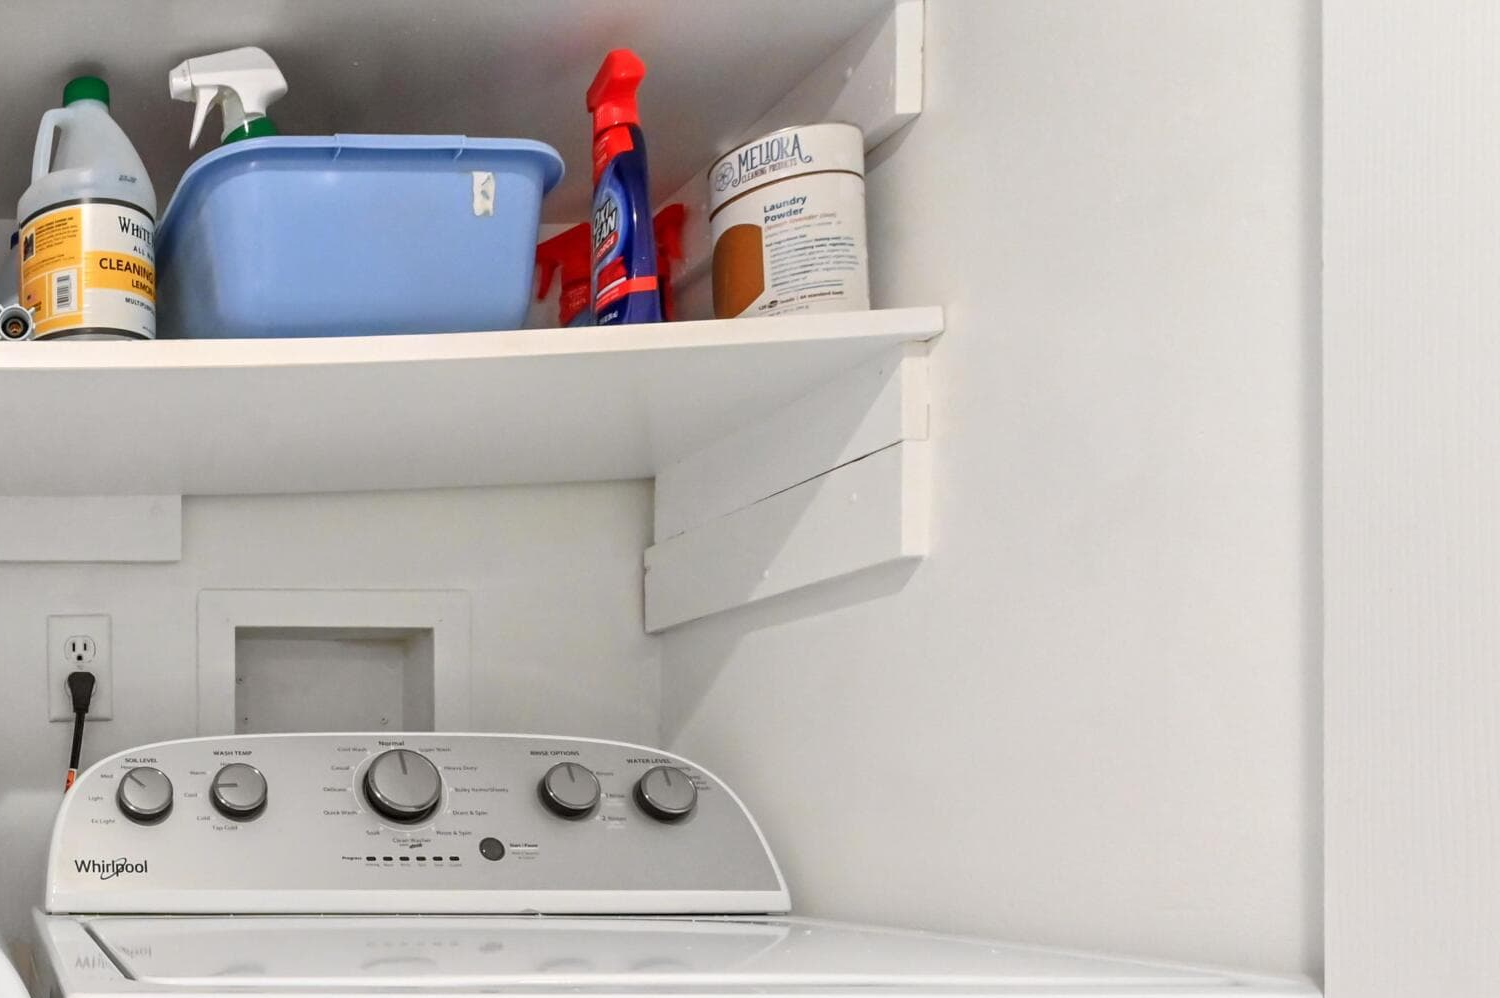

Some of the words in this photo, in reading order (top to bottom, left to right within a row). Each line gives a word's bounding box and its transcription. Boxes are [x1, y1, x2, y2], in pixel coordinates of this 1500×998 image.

[732, 133, 812, 188] MELIORA
[763, 196, 807, 214] Laundry
[764, 207, 804, 224] Powder
[99, 258, 155, 285] CLEANING
[75, 858, 148, 880] Whirlpool
